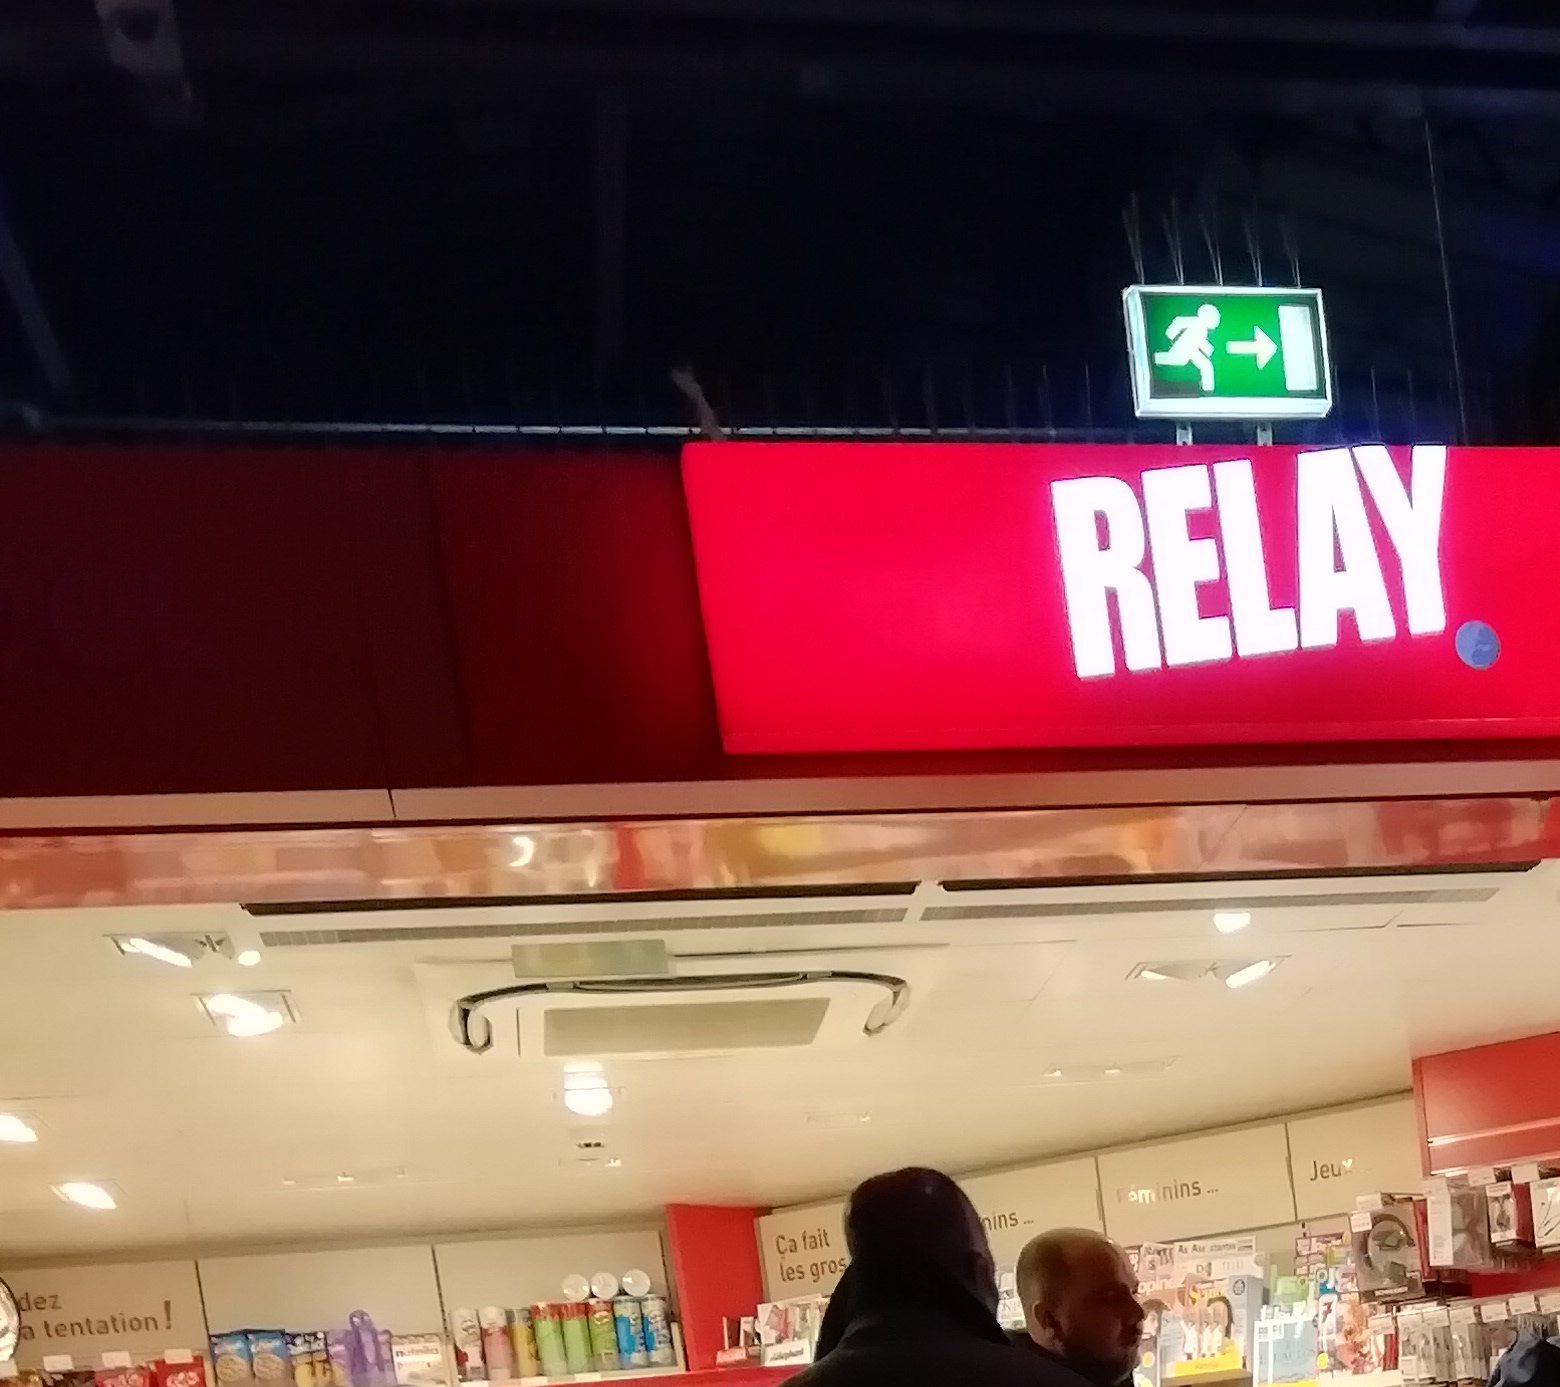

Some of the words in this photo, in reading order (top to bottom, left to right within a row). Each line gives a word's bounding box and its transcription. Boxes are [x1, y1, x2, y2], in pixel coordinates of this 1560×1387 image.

[1049, 443, 1448, 680] RELAY
[802, 1227, 831, 1251] fait
[779, 1262, 805, 1284] les
[18, 1291, 63, 1312] dez
